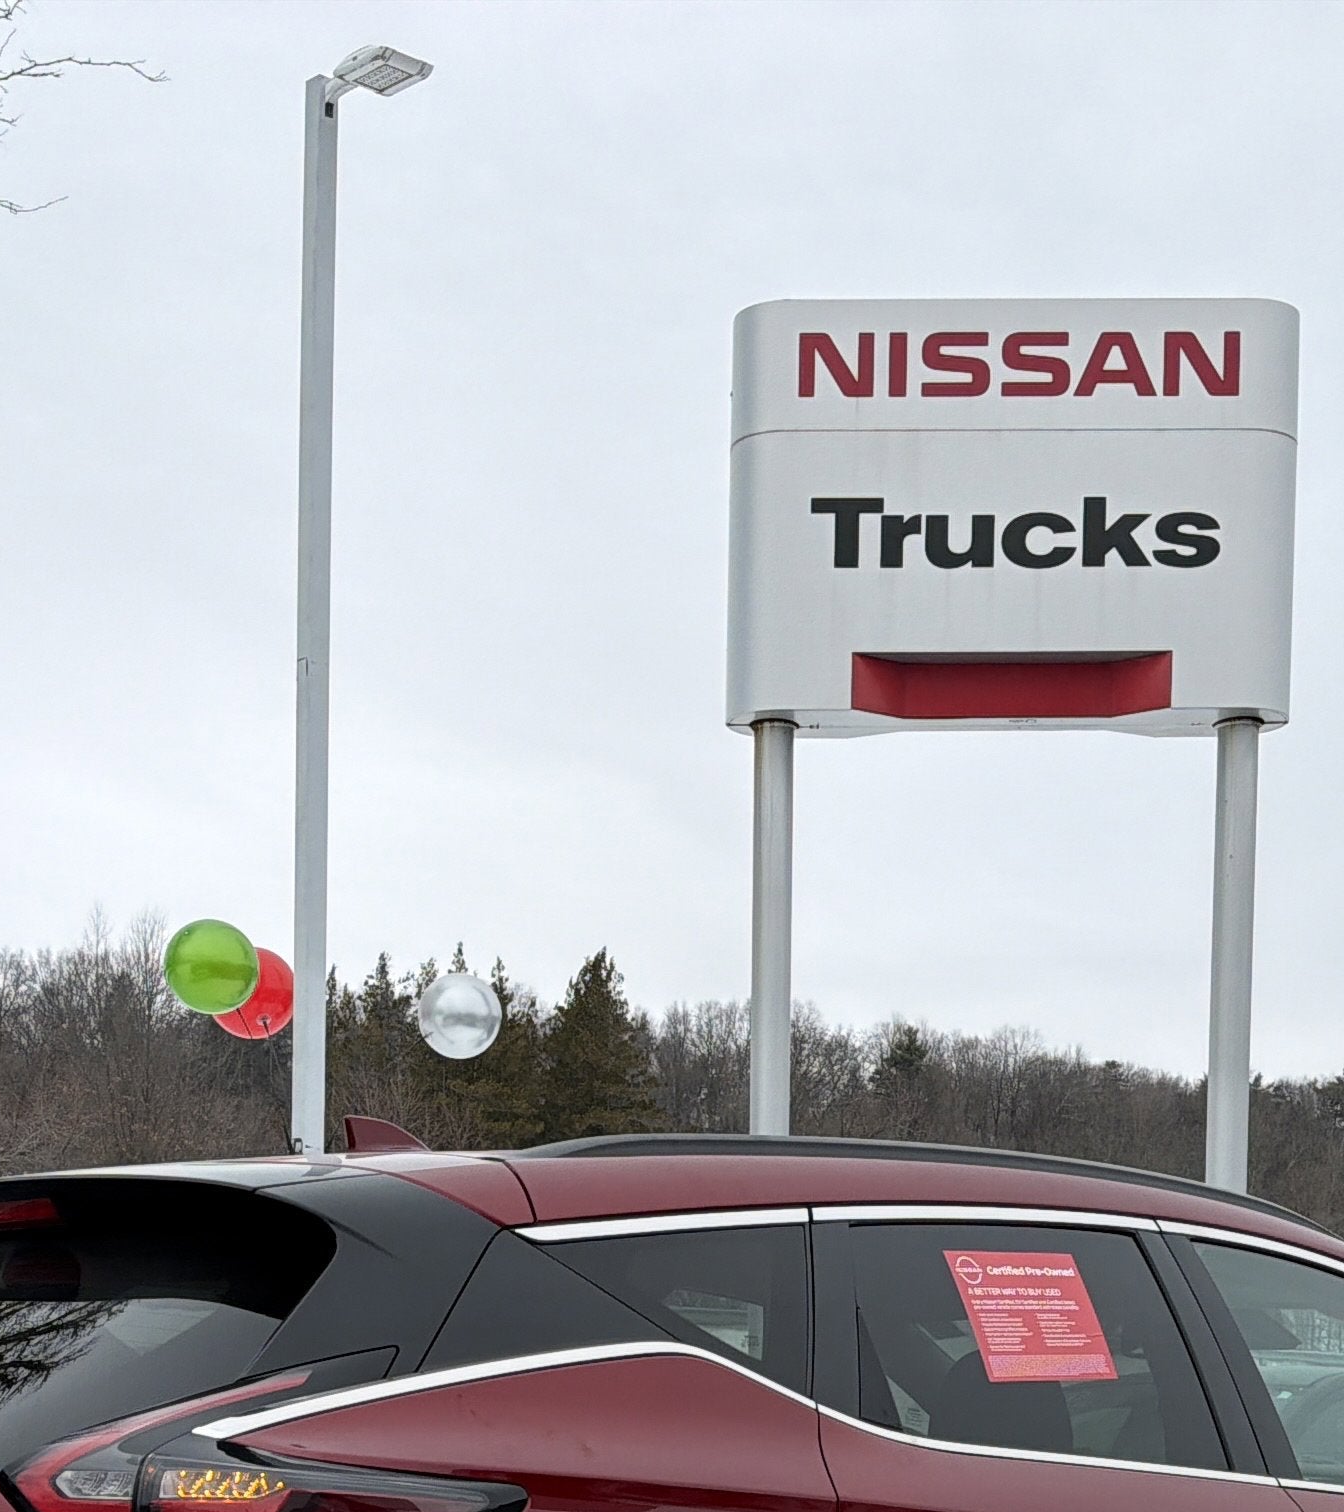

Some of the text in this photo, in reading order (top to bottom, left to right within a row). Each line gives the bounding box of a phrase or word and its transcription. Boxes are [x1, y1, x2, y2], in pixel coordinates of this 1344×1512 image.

[798, 331, 1241, 398] NISSAN
[810, 496, 1221, 569] Trucks
[986, 1265, 1025, 1276] Certified
